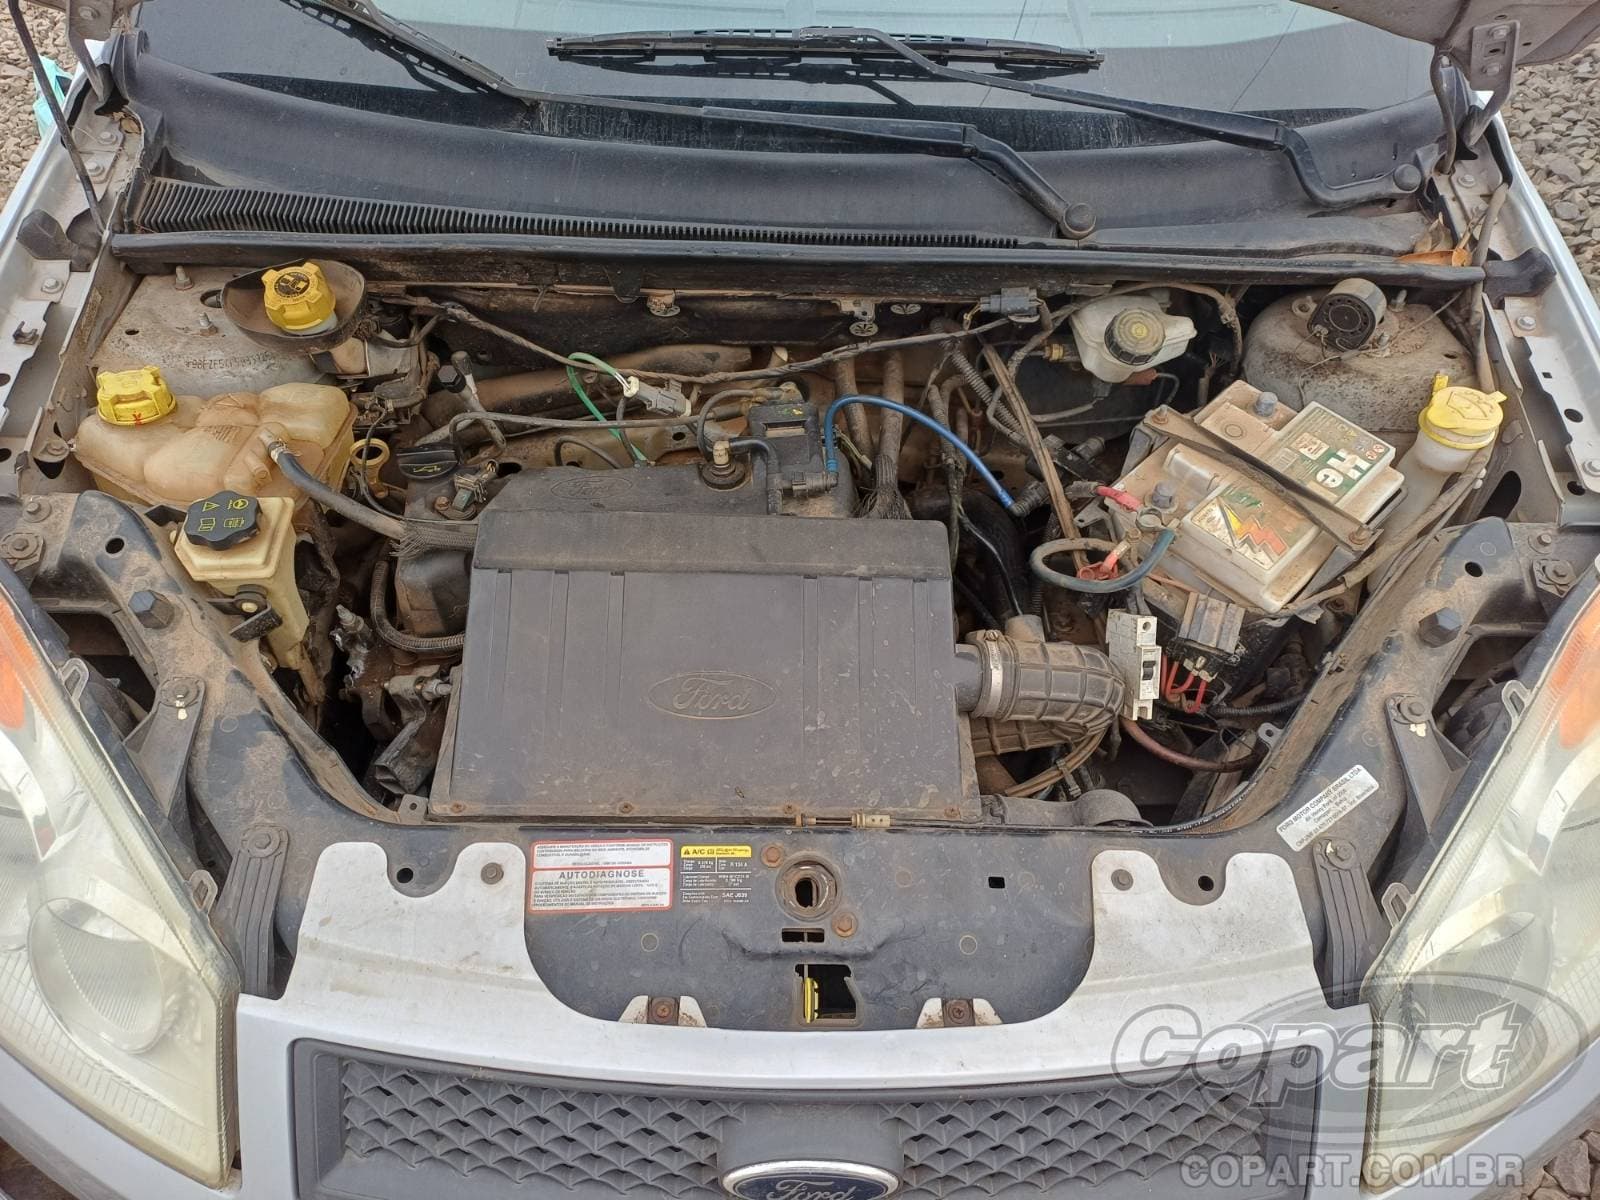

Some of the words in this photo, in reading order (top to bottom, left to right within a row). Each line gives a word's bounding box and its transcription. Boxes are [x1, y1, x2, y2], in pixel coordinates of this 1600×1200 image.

[672, 677, 753, 711] Ford
[1291, 805, 1311, 822] MOTOR
[1308, 788, 1334, 809] COMPANY
[692, 848, 706, 856] A/C
[559, 870, 645, 879] AUTODIAGNOSE
